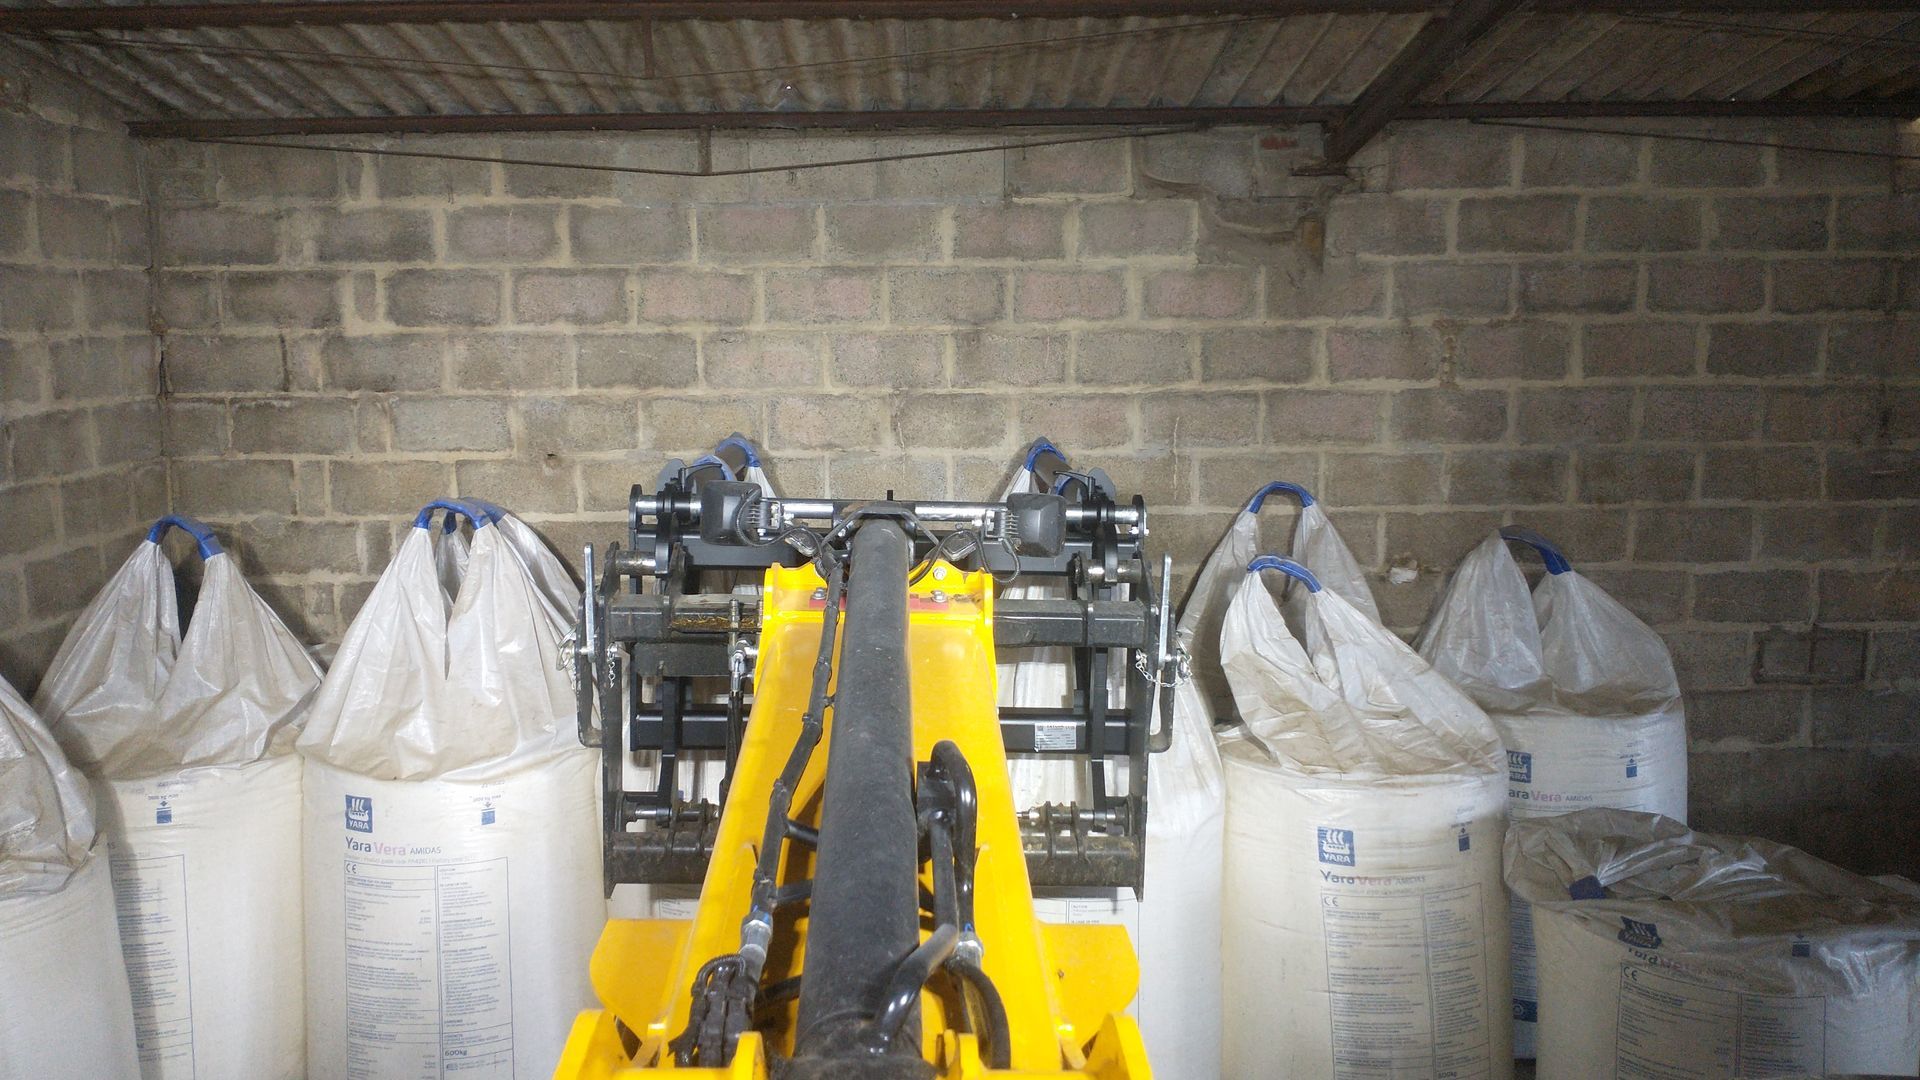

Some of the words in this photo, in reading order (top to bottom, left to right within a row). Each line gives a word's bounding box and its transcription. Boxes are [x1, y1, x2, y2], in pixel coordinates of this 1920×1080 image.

[1508, 789, 1529, 800] ara
[348, 820, 369, 830] YARA
[410, 846, 442, 855] AMIDAS
[1322, 852, 1351, 864] YARA
